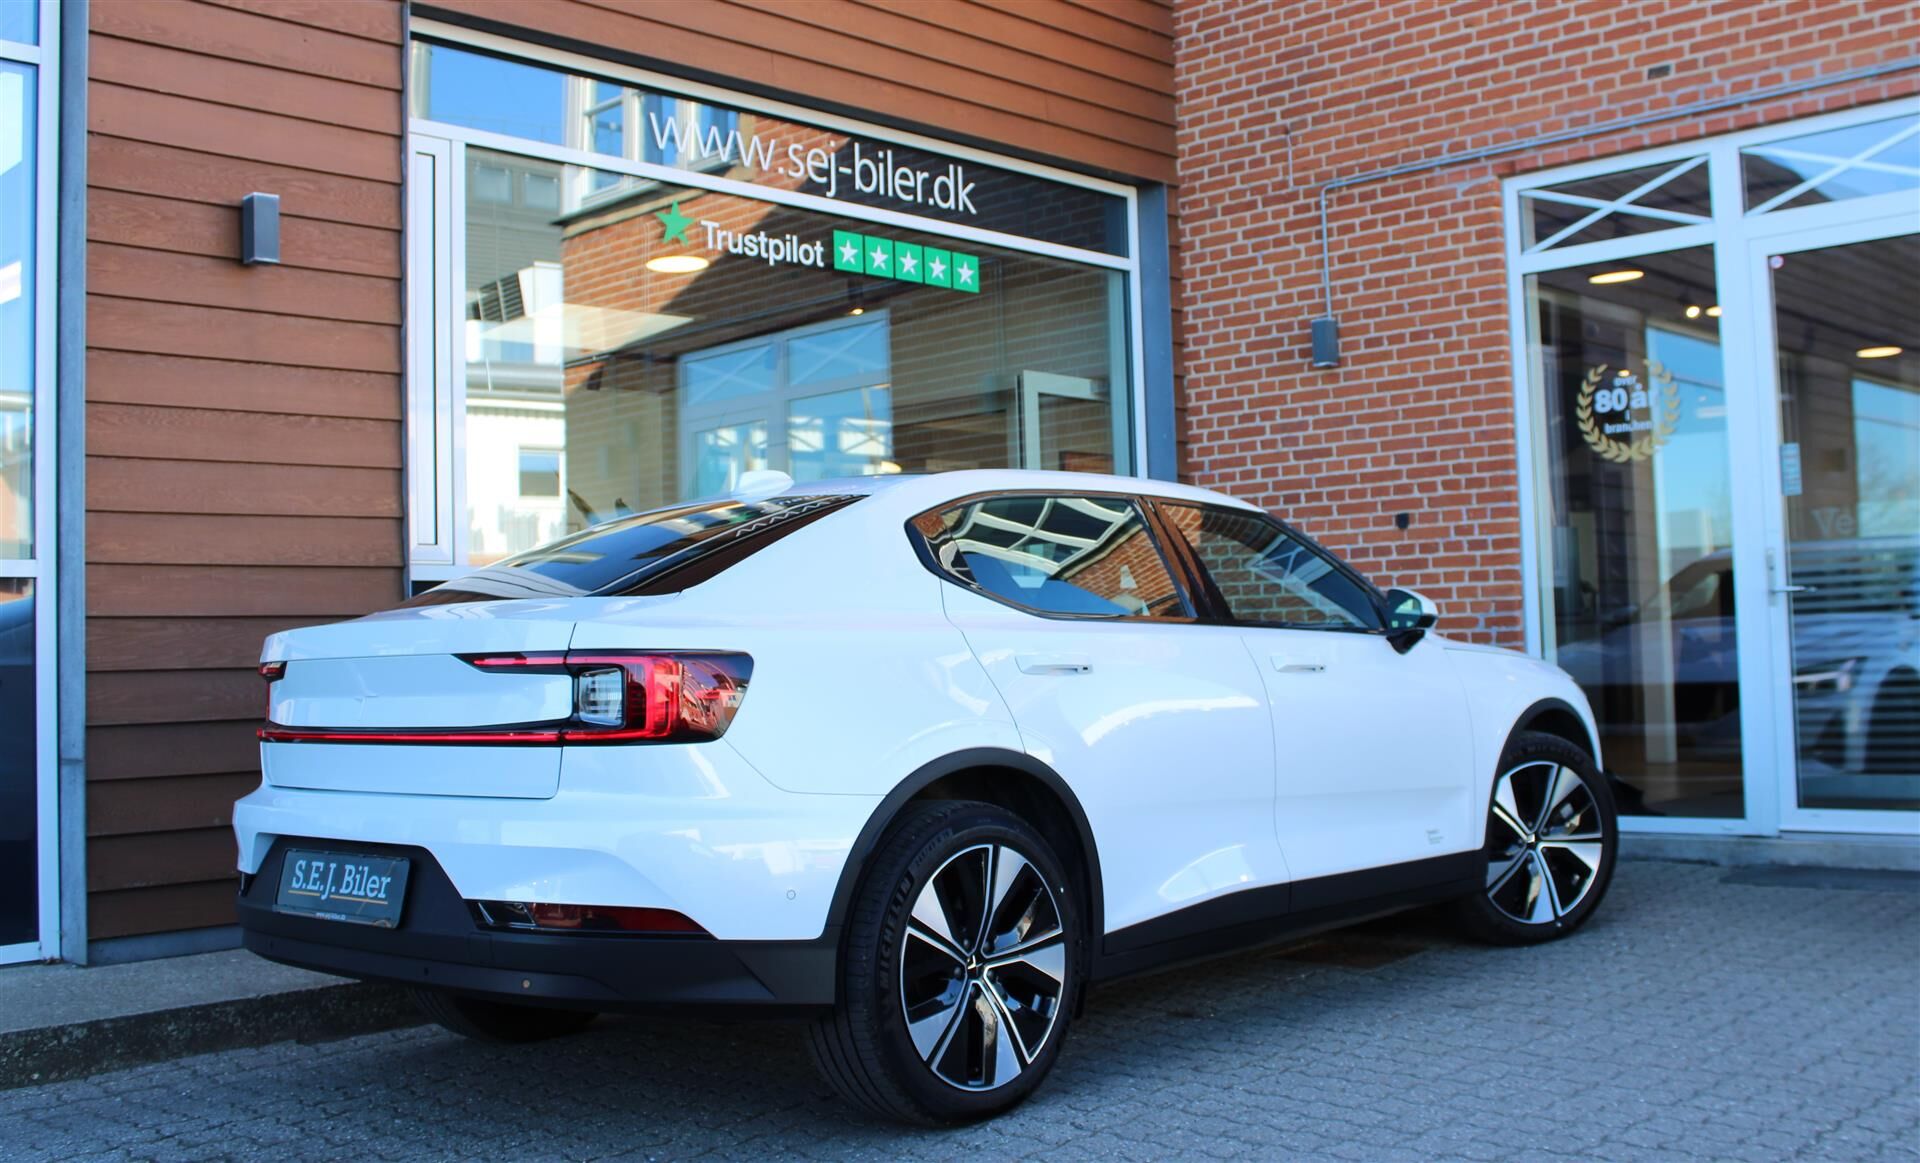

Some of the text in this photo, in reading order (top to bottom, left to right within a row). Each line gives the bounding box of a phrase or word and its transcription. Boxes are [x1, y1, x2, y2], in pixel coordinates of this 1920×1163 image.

[649, 112, 977, 214] www.sej-biler.dk
[701, 219, 825, 268] Trustpilot
[1594, 383, 1659, 413] 80 år
[291, 859, 392, 900] S.E.J. Biler
[879, 877, 912, 990] MICHELIN
